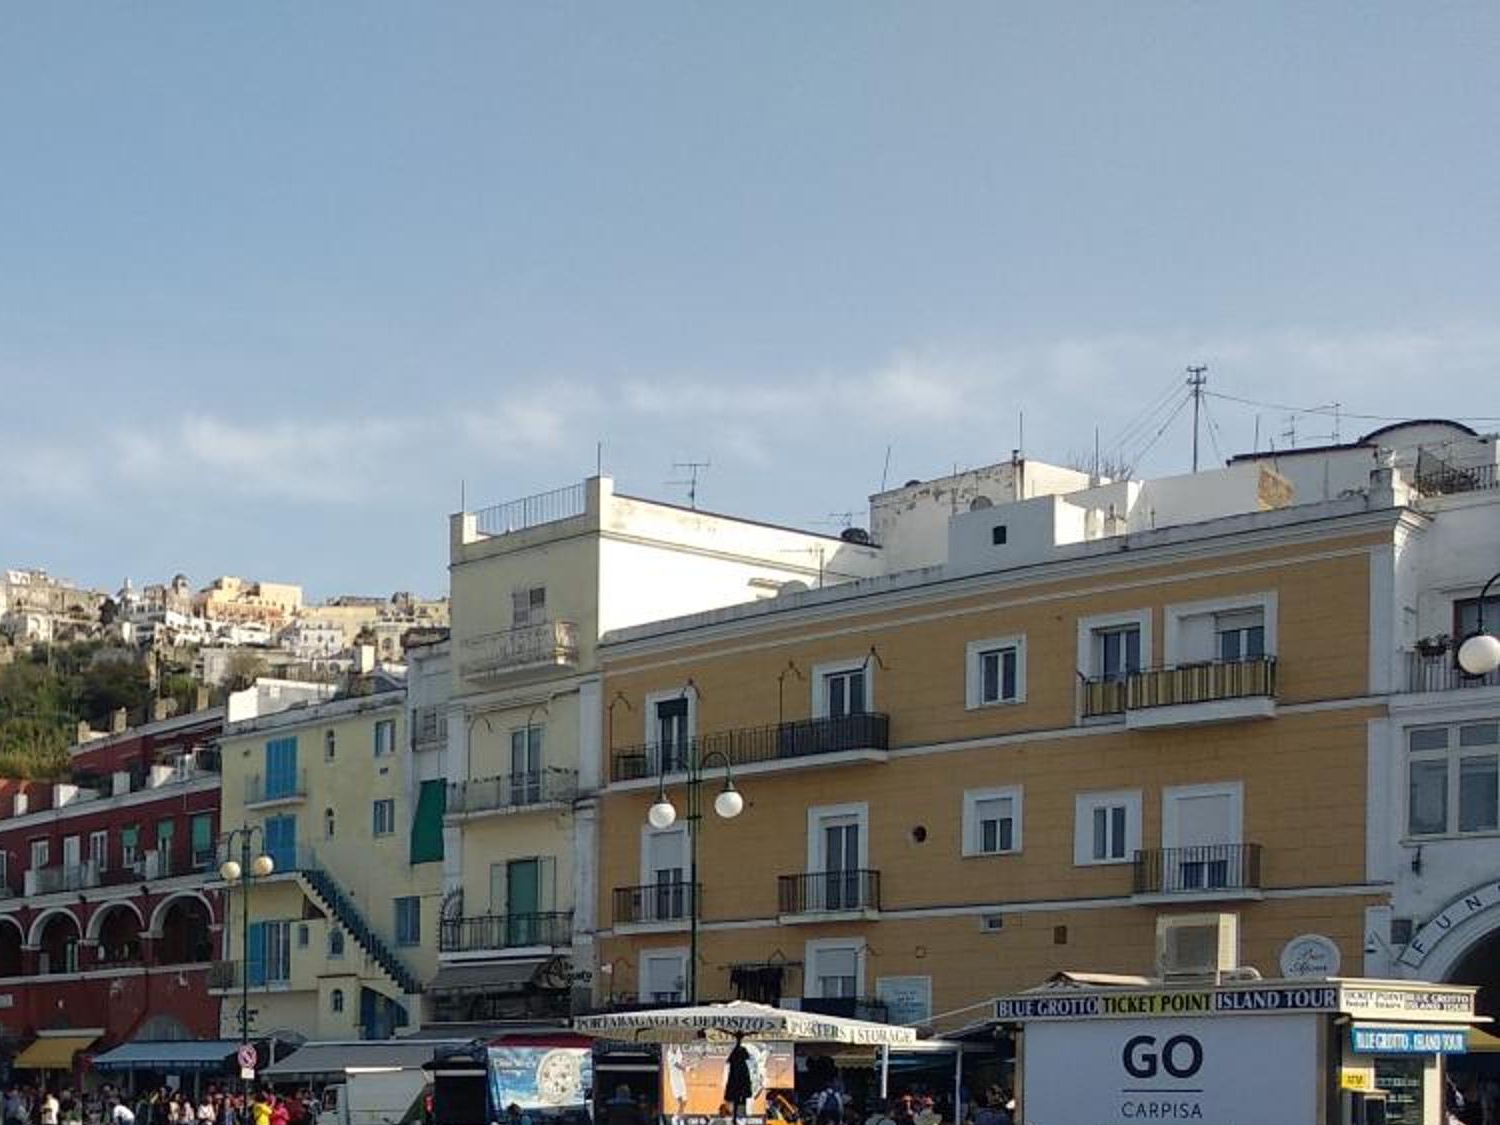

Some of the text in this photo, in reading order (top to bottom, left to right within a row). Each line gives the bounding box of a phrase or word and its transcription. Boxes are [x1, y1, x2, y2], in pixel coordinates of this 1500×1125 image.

[1411, 884, 1500, 955] FUN
[998, 988, 1336, 1018] BLUE GROTTO TICKET POINT ISLAND TOUR
[1355, 1031, 1376, 1049] BLUE
[1414, 1033, 1441, 1051] ISLAND
[1443, 1033, 1463, 1051] TOUR
[1122, 1034, 1203, 1079] GO
[1121, 1101, 1203, 1119] CARPISA
